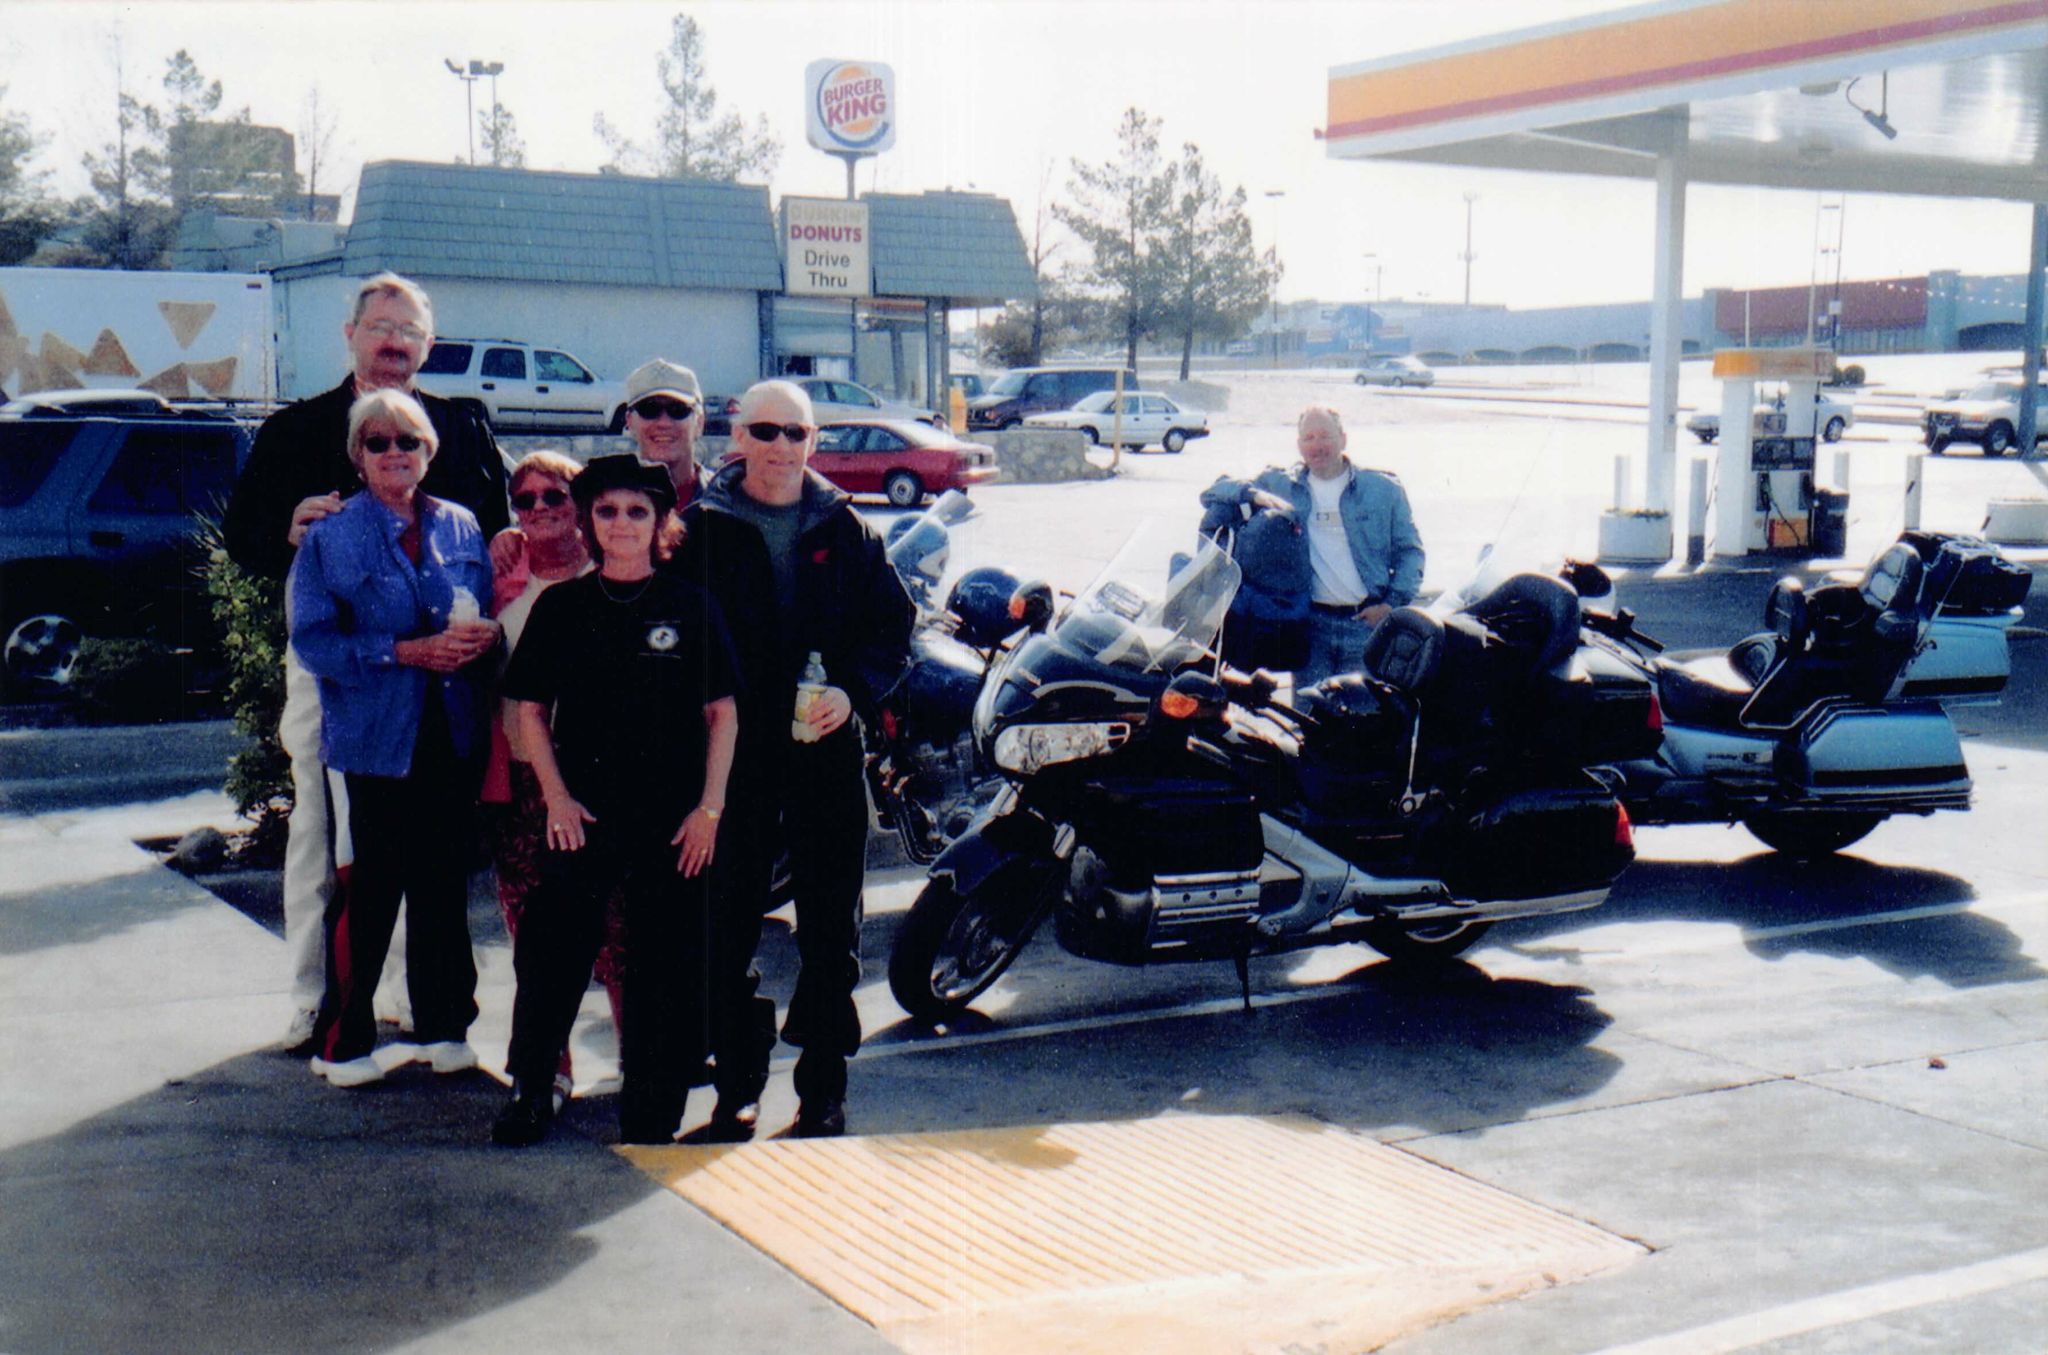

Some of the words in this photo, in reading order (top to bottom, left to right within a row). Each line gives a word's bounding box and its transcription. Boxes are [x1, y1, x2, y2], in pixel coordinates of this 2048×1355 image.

[824, 78, 883, 105] BURGER
[828, 94, 886, 128] KING
[791, 224, 862, 242] DONUTS
[805, 250, 850, 268] Drive
[808, 271, 848, 288] Thru
